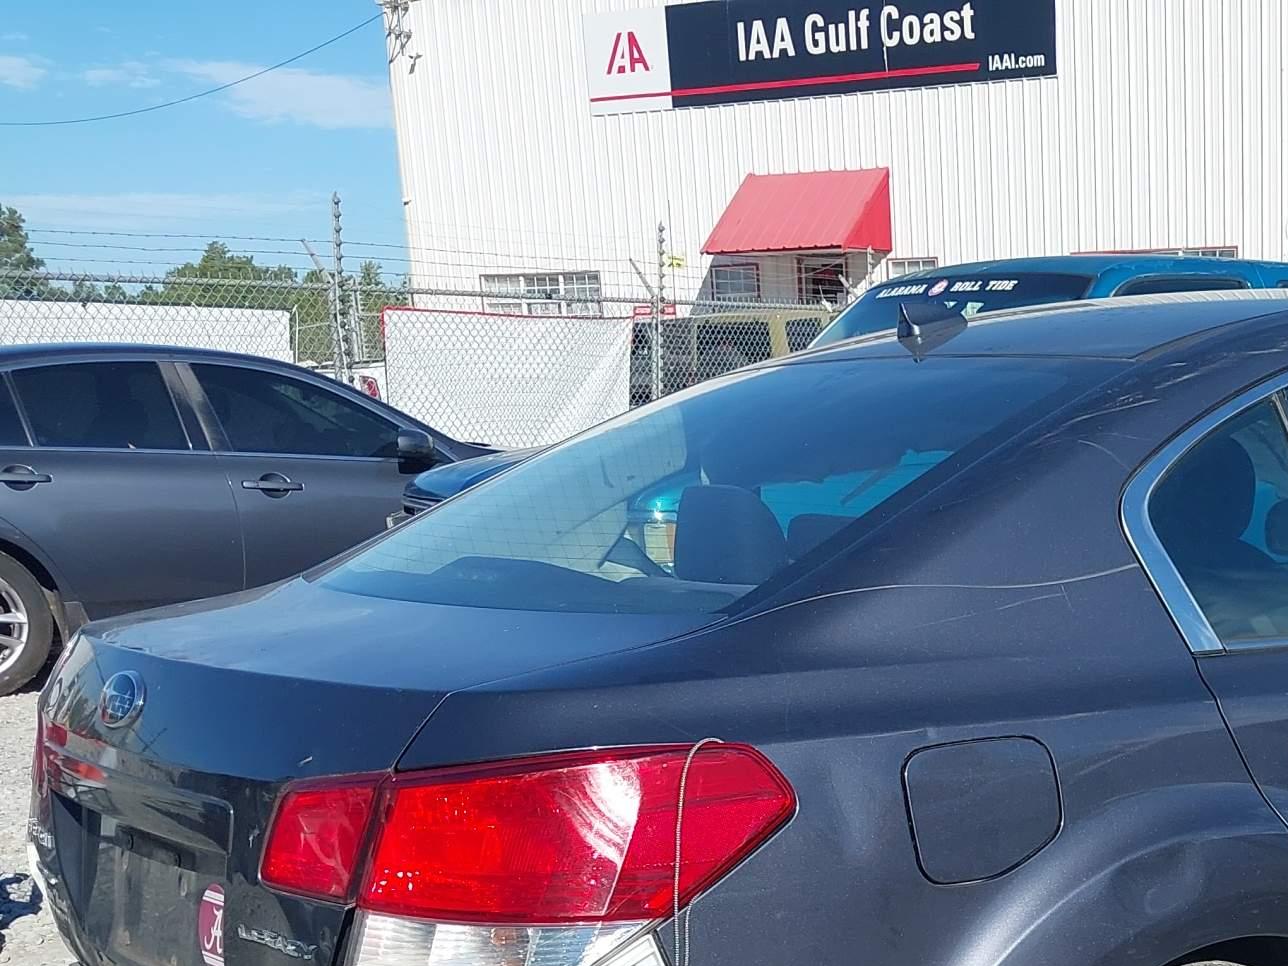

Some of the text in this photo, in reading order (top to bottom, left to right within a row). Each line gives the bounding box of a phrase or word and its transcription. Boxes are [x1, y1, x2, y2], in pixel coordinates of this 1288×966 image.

[736, 1, 976, 62] IAA Gulf Coast
[988, 53, 1046, 72] IAAI.com
[875, 283, 929, 299] ALABAMA
[950, 280, 984, 292] ROLL
[985, 280, 1019, 292] TIDE
